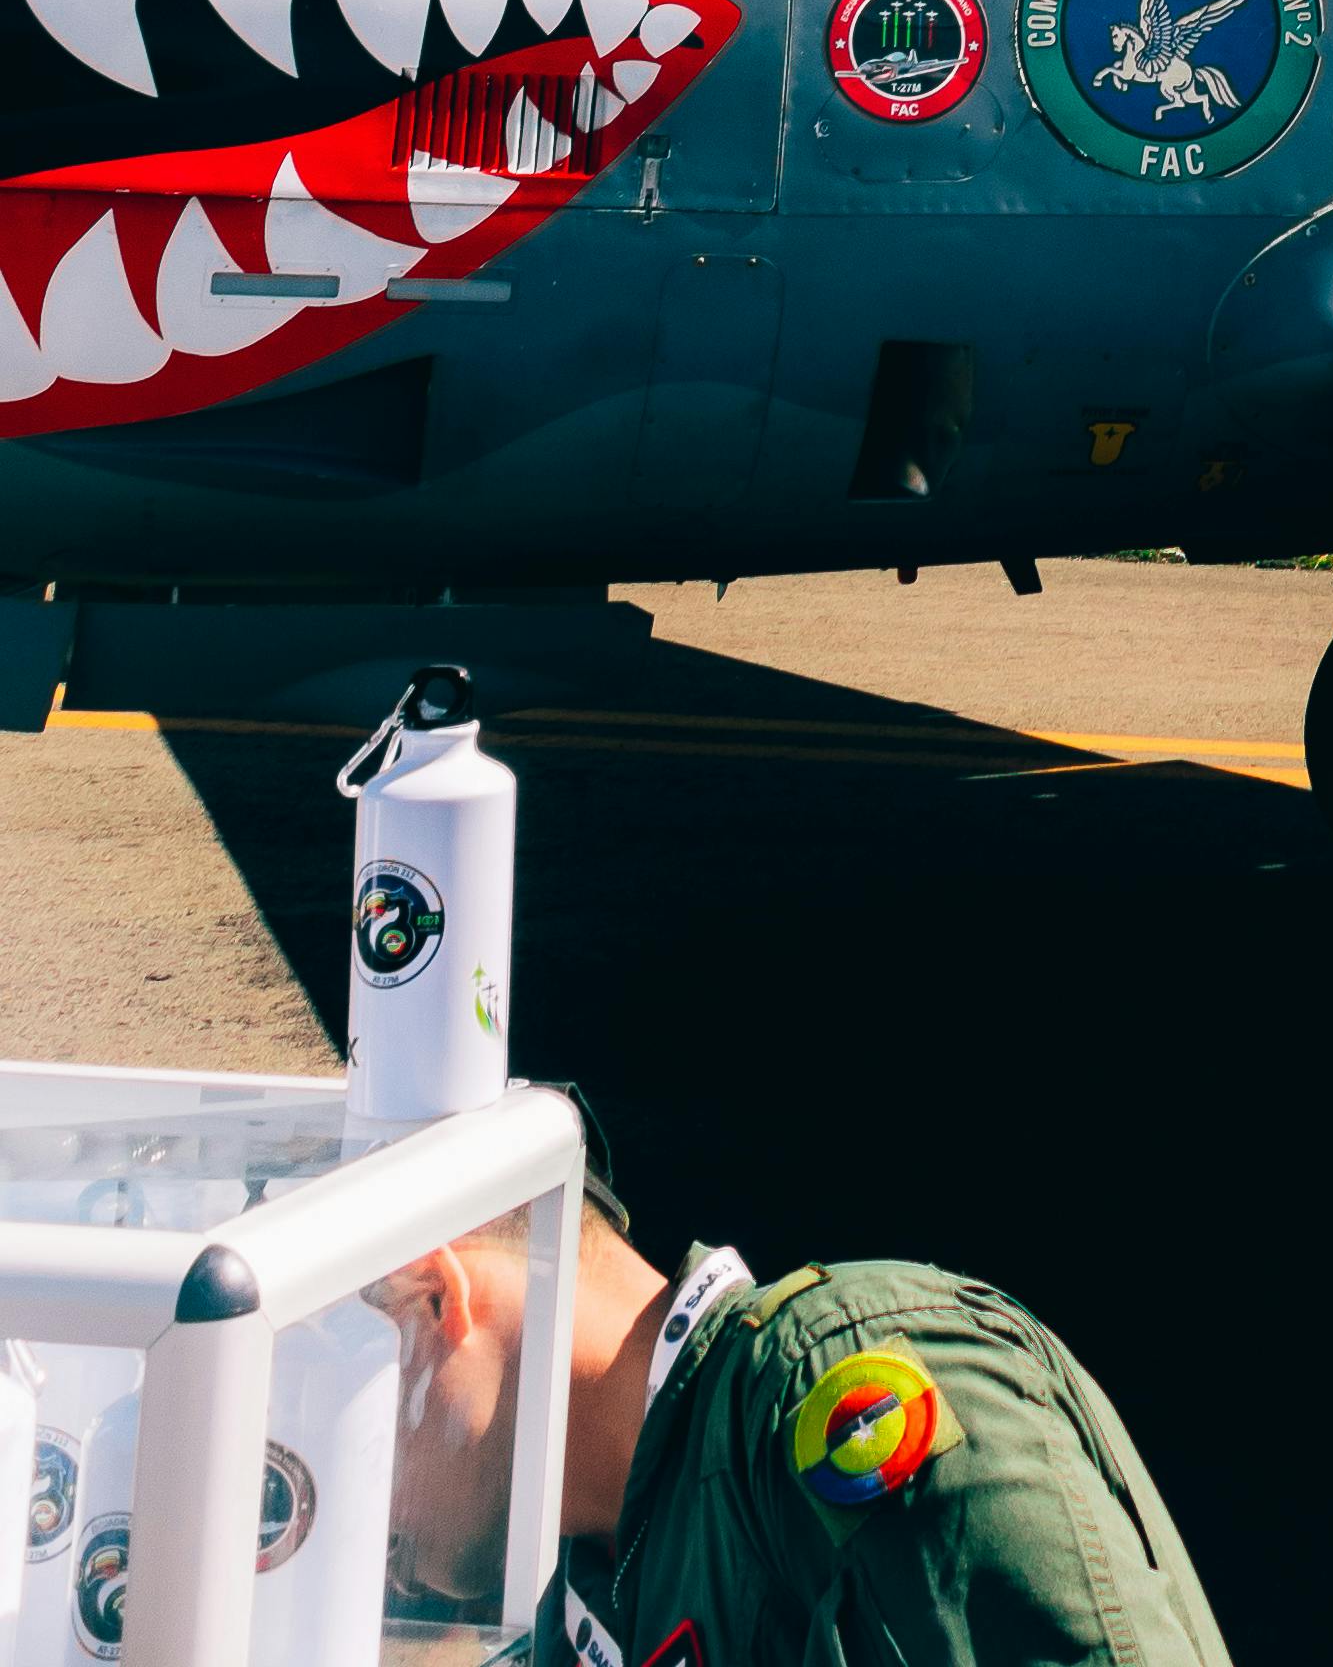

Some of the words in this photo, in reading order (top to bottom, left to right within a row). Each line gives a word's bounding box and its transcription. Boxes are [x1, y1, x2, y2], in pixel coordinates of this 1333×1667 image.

[1284, 29, 1313, 48] 2
[891, 82, 922, 93] T-27M
[890, 103, 920, 117] FAC
[1140, 143, 1205, 177] FAC
[684, 1263, 733, 1310] SAA
